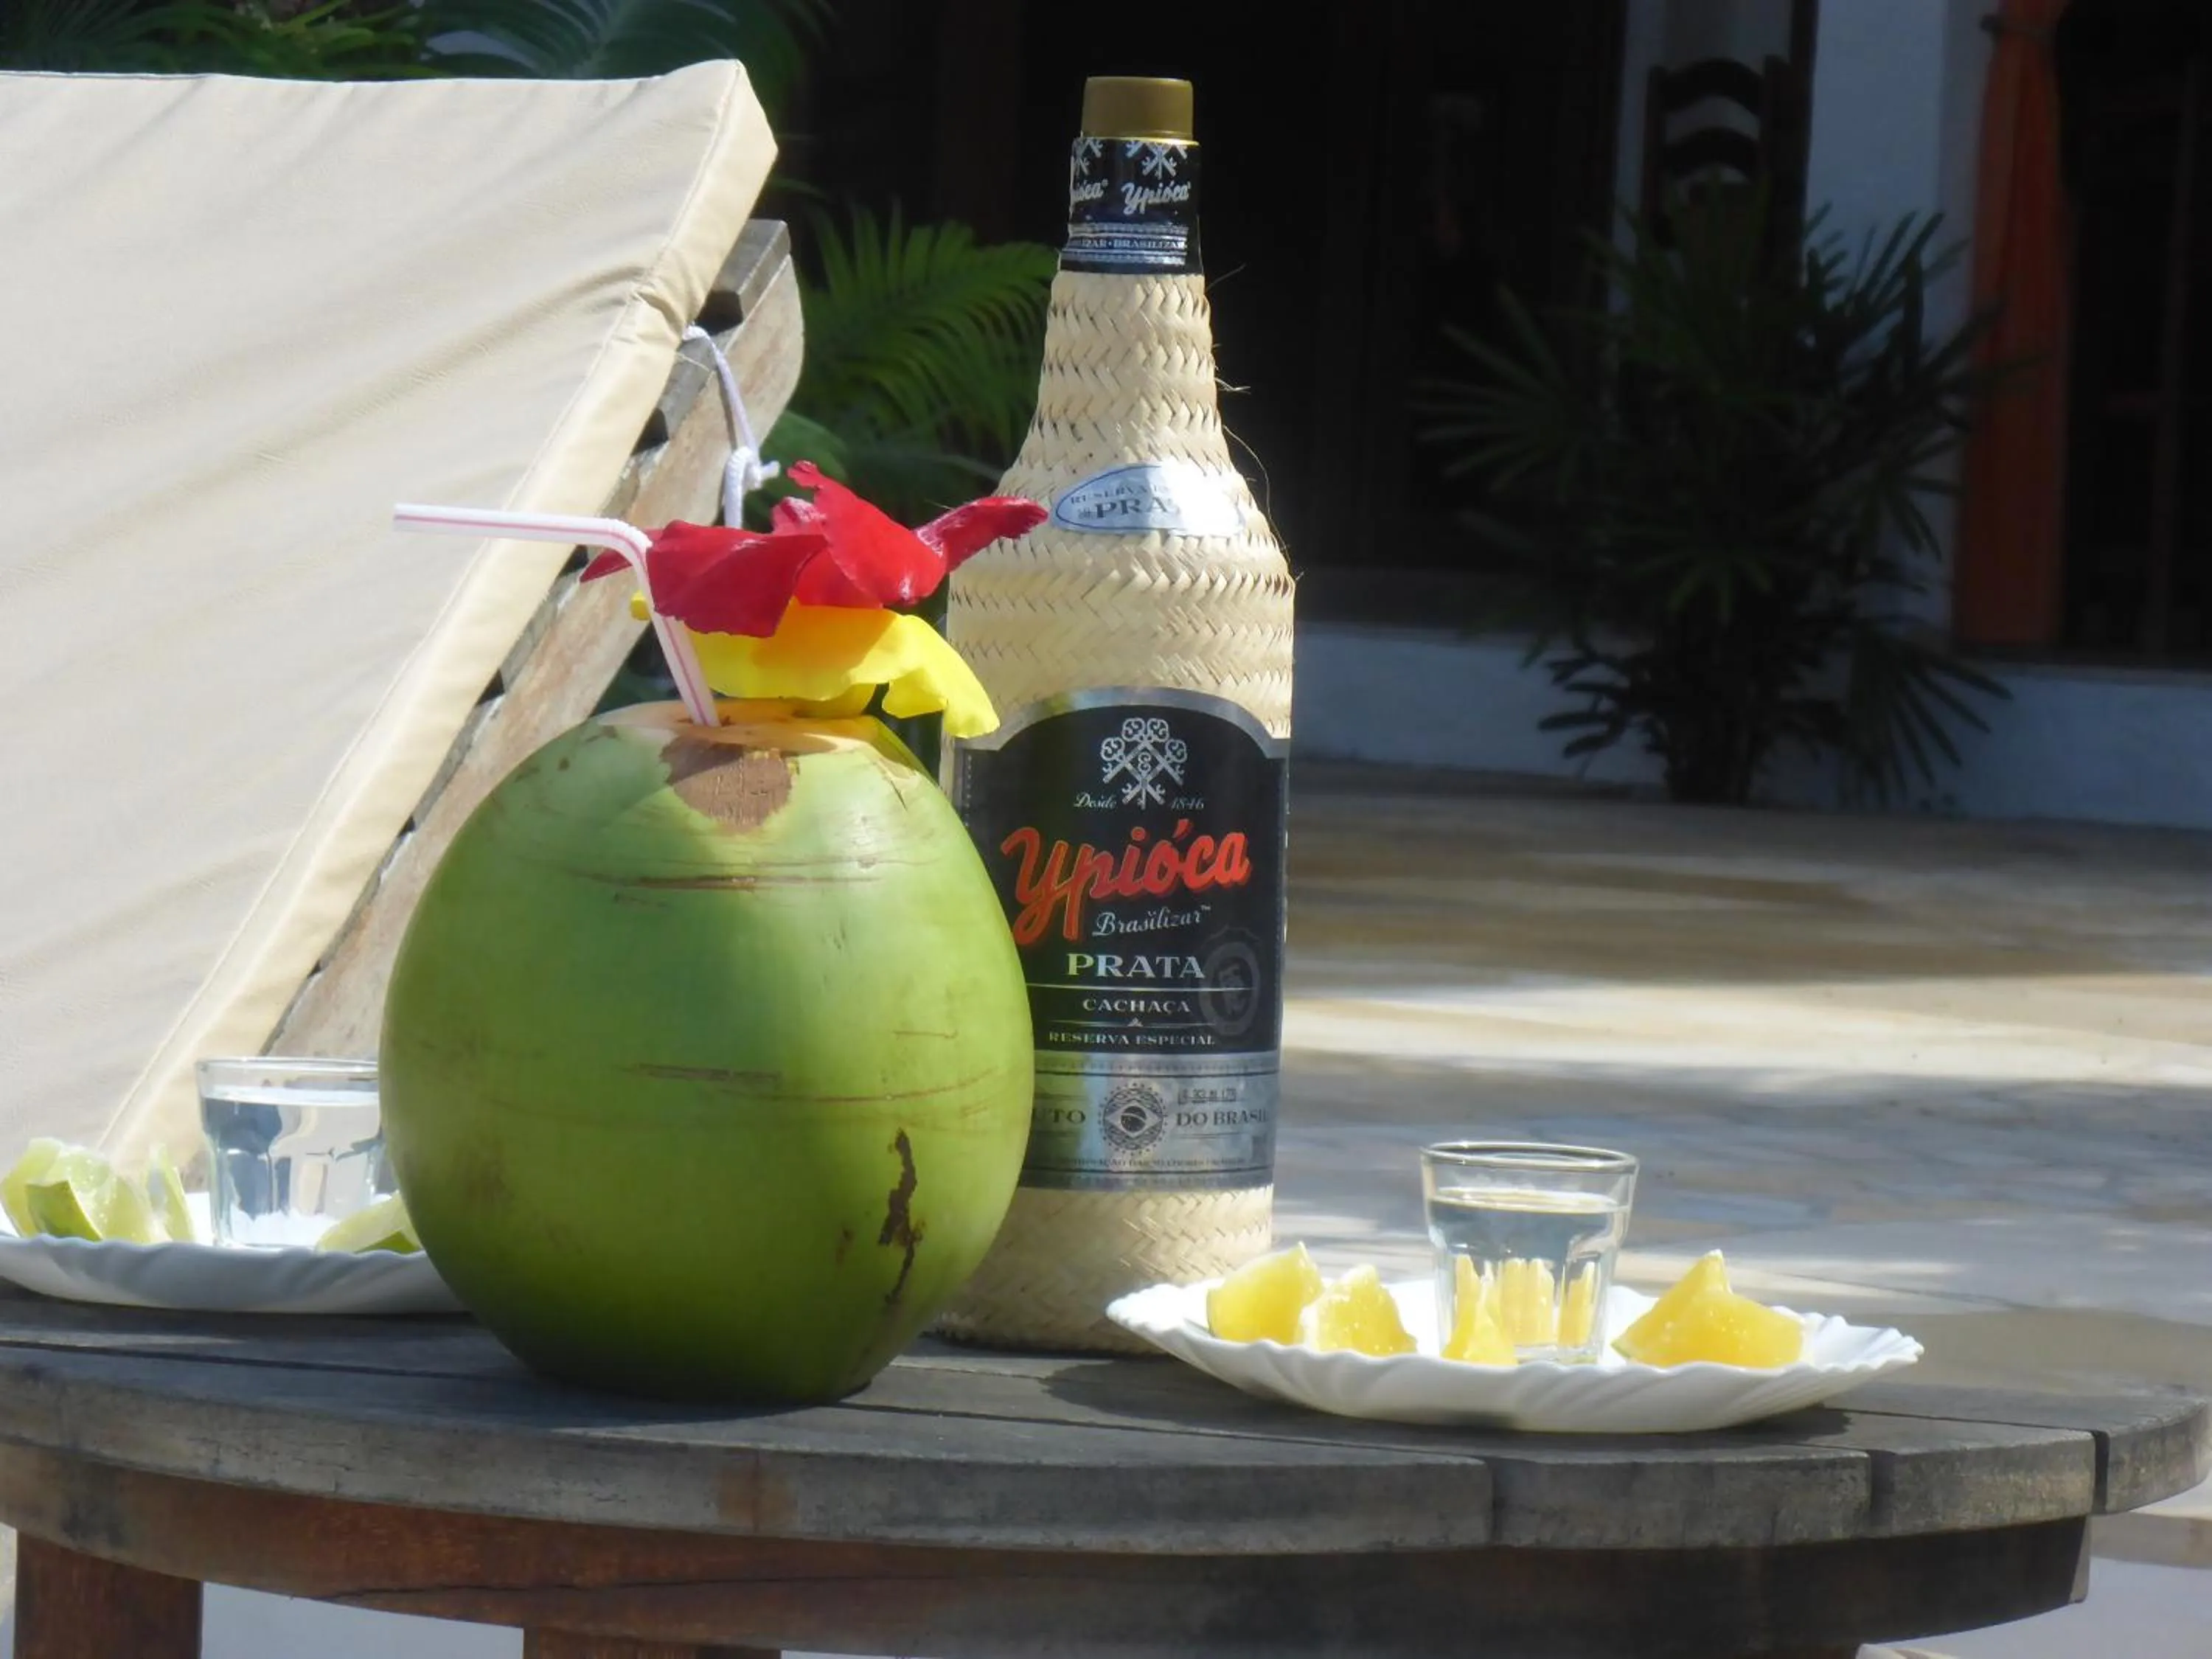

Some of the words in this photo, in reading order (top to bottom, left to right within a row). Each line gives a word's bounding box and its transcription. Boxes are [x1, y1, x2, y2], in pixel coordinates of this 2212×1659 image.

[1121, 181, 1189, 215] Ypióca
[1001, 818, 1253, 945] Ypióca
[1066, 953, 1206, 979] PRATA
[1083, 998, 1191, 1015] CACHAÇA
[1048, 1032, 1130, 1046] RESERVA
[1136, 1034, 1215, 1046] ESPECIAL
[1176, 1112, 1208, 1127] DO
